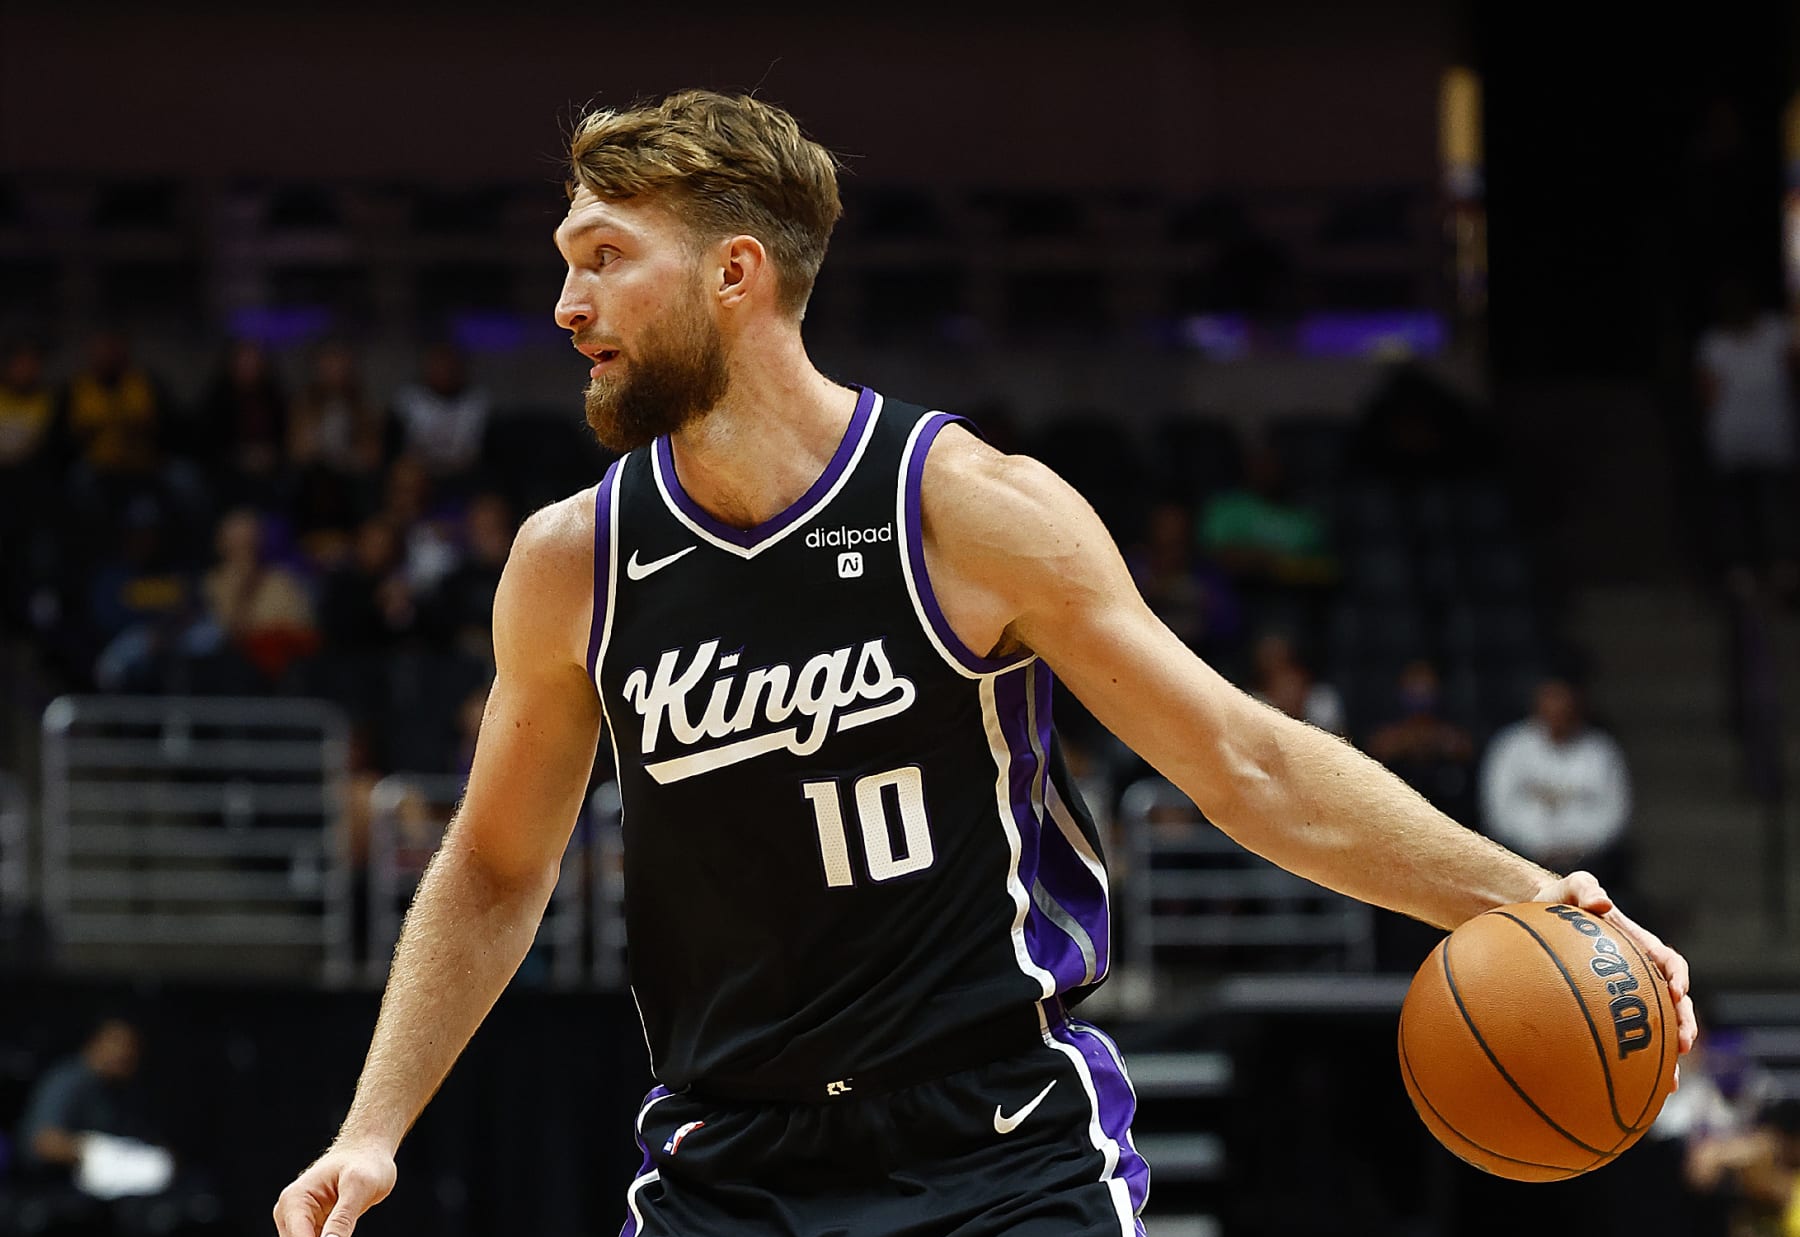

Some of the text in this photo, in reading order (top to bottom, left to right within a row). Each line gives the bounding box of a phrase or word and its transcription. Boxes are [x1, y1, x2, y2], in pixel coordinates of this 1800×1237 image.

[805, 522, 892, 549] dialpad
[622, 637, 917, 785] Kings
[802, 765, 935, 888] 10
[1544, 904, 1653, 1060] Wilson
